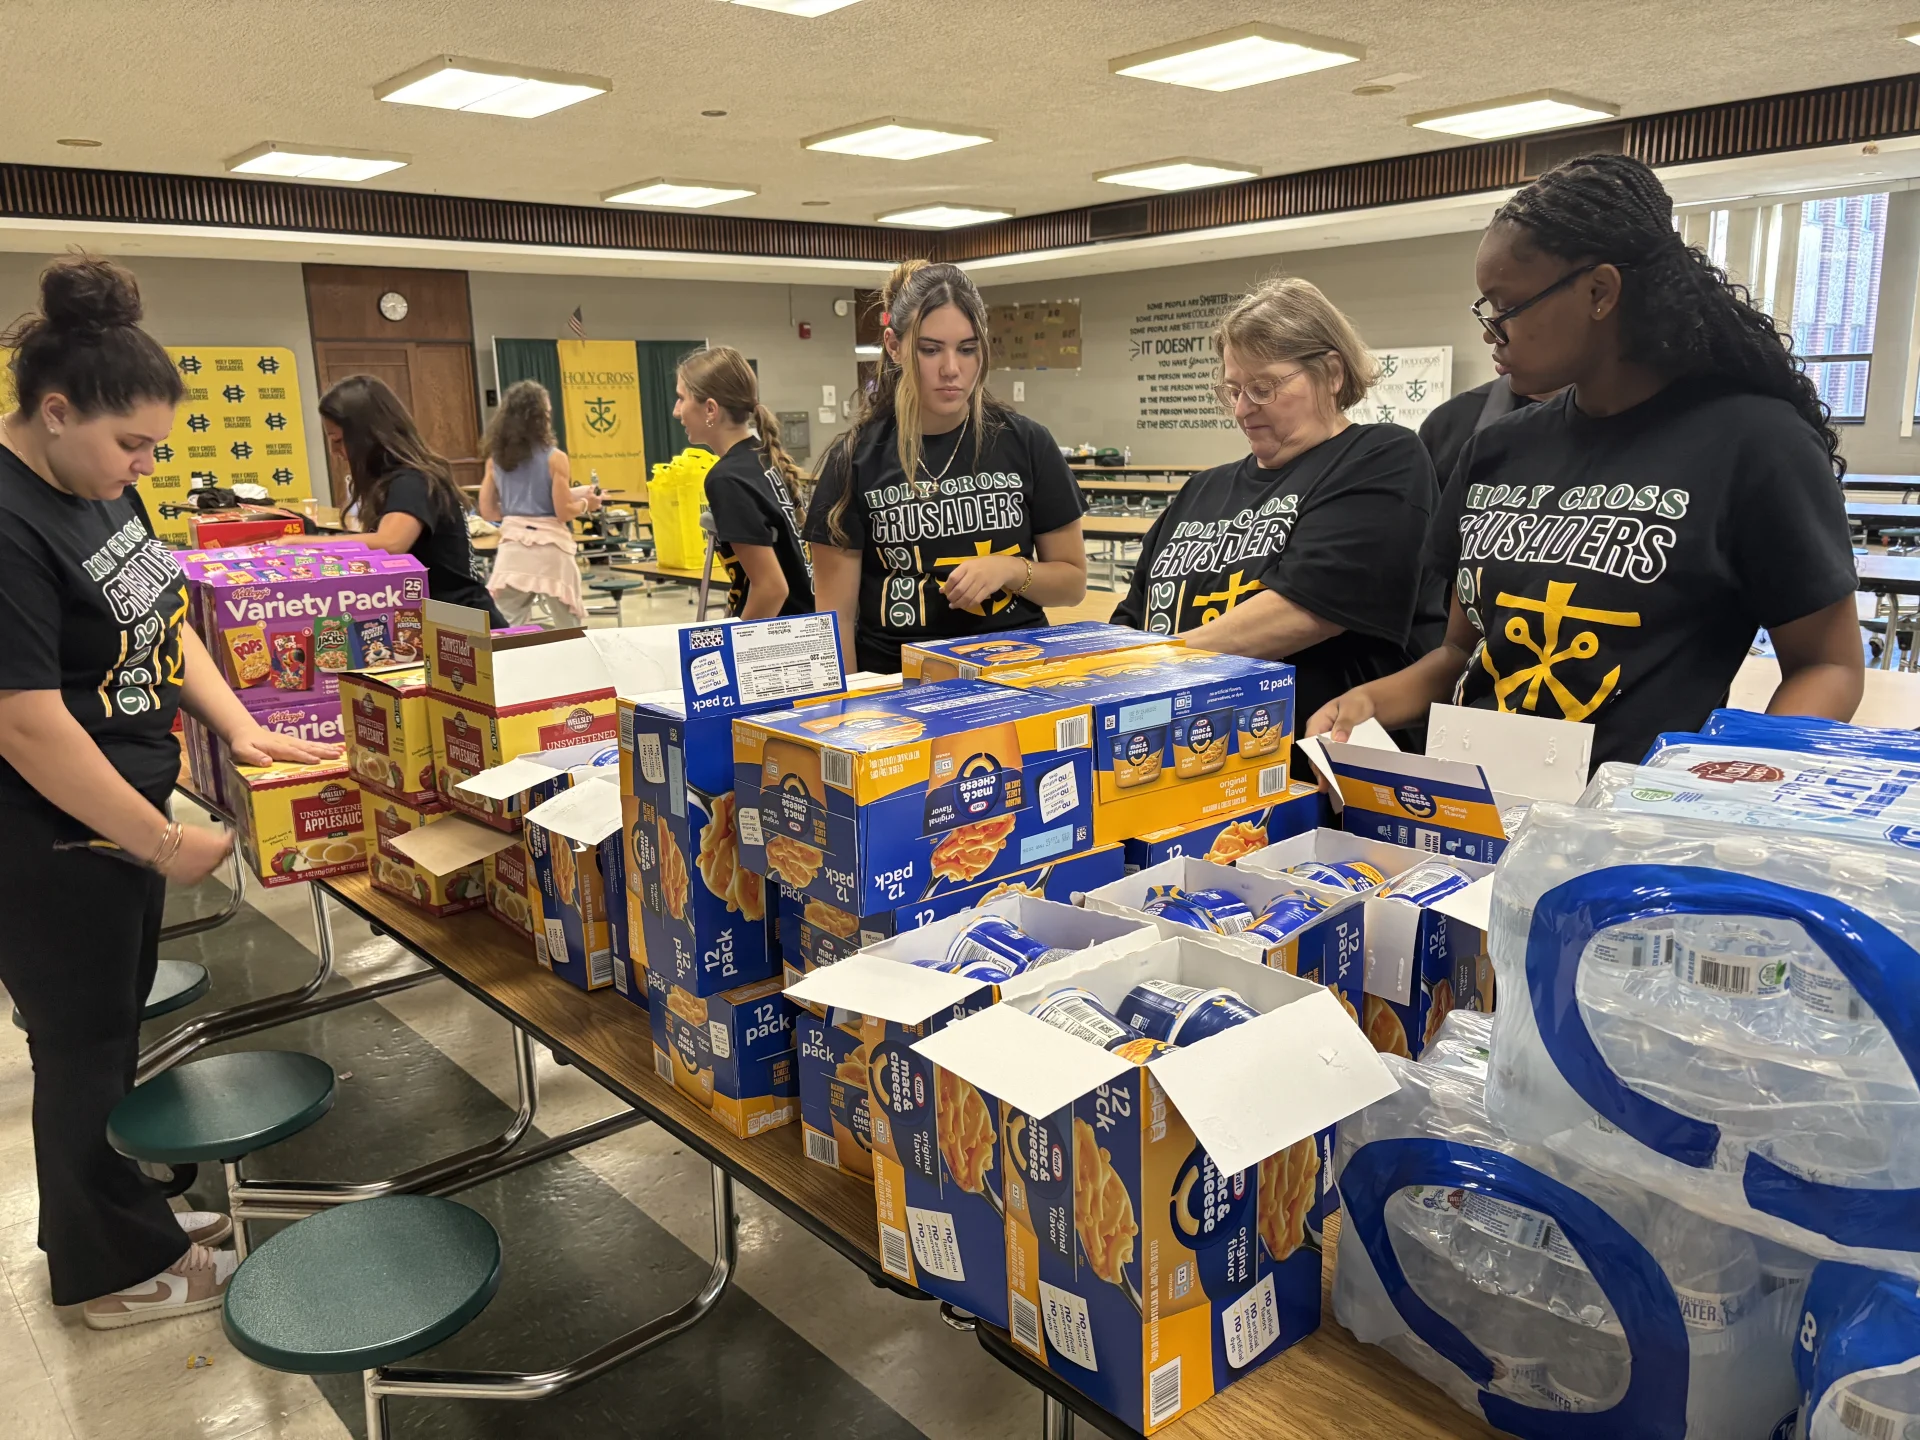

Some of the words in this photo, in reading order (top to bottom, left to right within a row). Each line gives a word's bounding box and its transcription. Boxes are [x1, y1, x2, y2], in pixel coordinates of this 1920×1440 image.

[1165, 300, 1186, 308] PEOPLE
[1200, 294, 1228, 306] SMARTER
[1142, 340, 1152, 355] IT
[1156, 336, 1204, 354] DOESN'T
[563, 372, 596, 384] HOLY
[597, 372, 634, 384] CROSS
[864, 481, 932, 509] HOLY
[940, 472, 1022, 494] CROSS
[1466, 484, 1554, 510] HOLY
[1558, 484, 1690, 520] CROSS
[869, 492, 1024, 543] CRUSADERS
[284, 524, 300, 534] 45
[232, 586, 271, 600] Kellogg's
[406, 580, 421, 592] 25
[224, 592, 332, 622] Variety
[338, 584, 404, 612] Pack
[361, 625, 384, 637] FROSTED
[234, 639, 264, 662] POPS
[316, 634, 346, 652] JACKS
[1258, 680, 1270, 692] 12
[1271, 674, 1293, 692] pack
[692, 694, 720, 712] pack
[722, 696, 735, 708] 12
[268, 710, 305, 724] Kellogg's
[566, 714, 593, 726] WELLSLEY
[358, 724, 385, 746] APPLESAUCE
[547, 730, 617, 750] UNSWEETENED
[450, 744, 481, 768] APPLESAUCE
[1058, 774, 1067, 782] no
[1220, 774, 1248, 788] original
[972, 786, 994, 798] mac
[1060, 787, 1069, 796] no
[1226, 786, 1246, 798] flavor
[1401, 791, 1420, 800] mac
[299, 803, 362, 820] UNSWEETENE
[764, 808, 778, 818] flavor
[932, 804, 952, 816] flavor
[970, 801, 986, 812] Kraft
[1062, 800, 1070, 810] no
[1440, 804, 1468, 814] original
[304, 811, 362, 832] APPLESAUC
[762, 814, 780, 825] original
[790, 810, 804, 822] mac
[928, 812, 956, 828] original
[1166, 844, 1182, 858] 12
[825, 866, 854, 888] pack
[874, 860, 914, 887] pack
[780, 884, 804, 904] pack
[836, 884, 850, 903] 12
[888, 883, 906, 900] 12
[914, 910, 935, 928] 12
[1348, 927, 1360, 956] 12
[1429, 933, 1439, 955] 12
[1438, 914, 1448, 959] pack
[672, 936, 684, 980] pack
[682, 950, 691, 970] 12
[704, 948, 720, 973] 12
[716, 928, 738, 978] pack
[818, 948, 832, 960] mac
[1336, 922, 1351, 980] pack
[648, 974, 666, 994] pack
[754, 1004, 774, 1024] 12
[678, 1033, 690, 1046] mac
[746, 1013, 790, 1046] pack
[808, 1030, 824, 1047] 12
[802, 1042, 835, 1064] pack
[900, 1060, 912, 1098] mac
[903, 1100, 914, 1111] &
[1096, 1084, 1116, 1132] ack
[1112, 1086, 1131, 1118] 12
[914, 1133, 922, 1168] flavor
[921, 1130, 933, 1176] original
[1038, 1125, 1048, 1168] mac
[1040, 1168, 1050, 1182] &
[1217, 1203, 1230, 1222] &
[918, 1222, 925, 1239] no
[932, 1224, 940, 1242] no
[1049, 1206, 1058, 1244] flavor
[1058, 1206, 1068, 1254] original
[945, 1228, 952, 1244] no
[920, 1239, 930, 1267] artificial
[926, 1224, 940, 1270] preservatives
[934, 1242, 944, 1270] artificial
[1236, 1226, 1248, 1282] original
[948, 1244, 958, 1273] artificial
[1228, 1238, 1238, 1282] flavor
[1050, 1300, 1057, 1317] no
[1264, 1290, 1272, 1308] no
[1250, 1302, 1258, 1320] no
[1058, 1304, 1070, 1352] preservatives
[1064, 1306, 1072, 1323] no
[1068, 1324, 1076, 1354] artificial
[1234, 1315, 1242, 1333] no
[1244, 1308, 1254, 1353] preservatives
[1266, 1308, 1274, 1336] artificial
[1052, 1318, 1062, 1348] artificial
[1078, 1312, 1086, 1330] no
[1082, 1330, 1090, 1362] artificial
[1252, 1320, 1260, 1349] artificial
[1236, 1334, 1244, 1362] artificial
